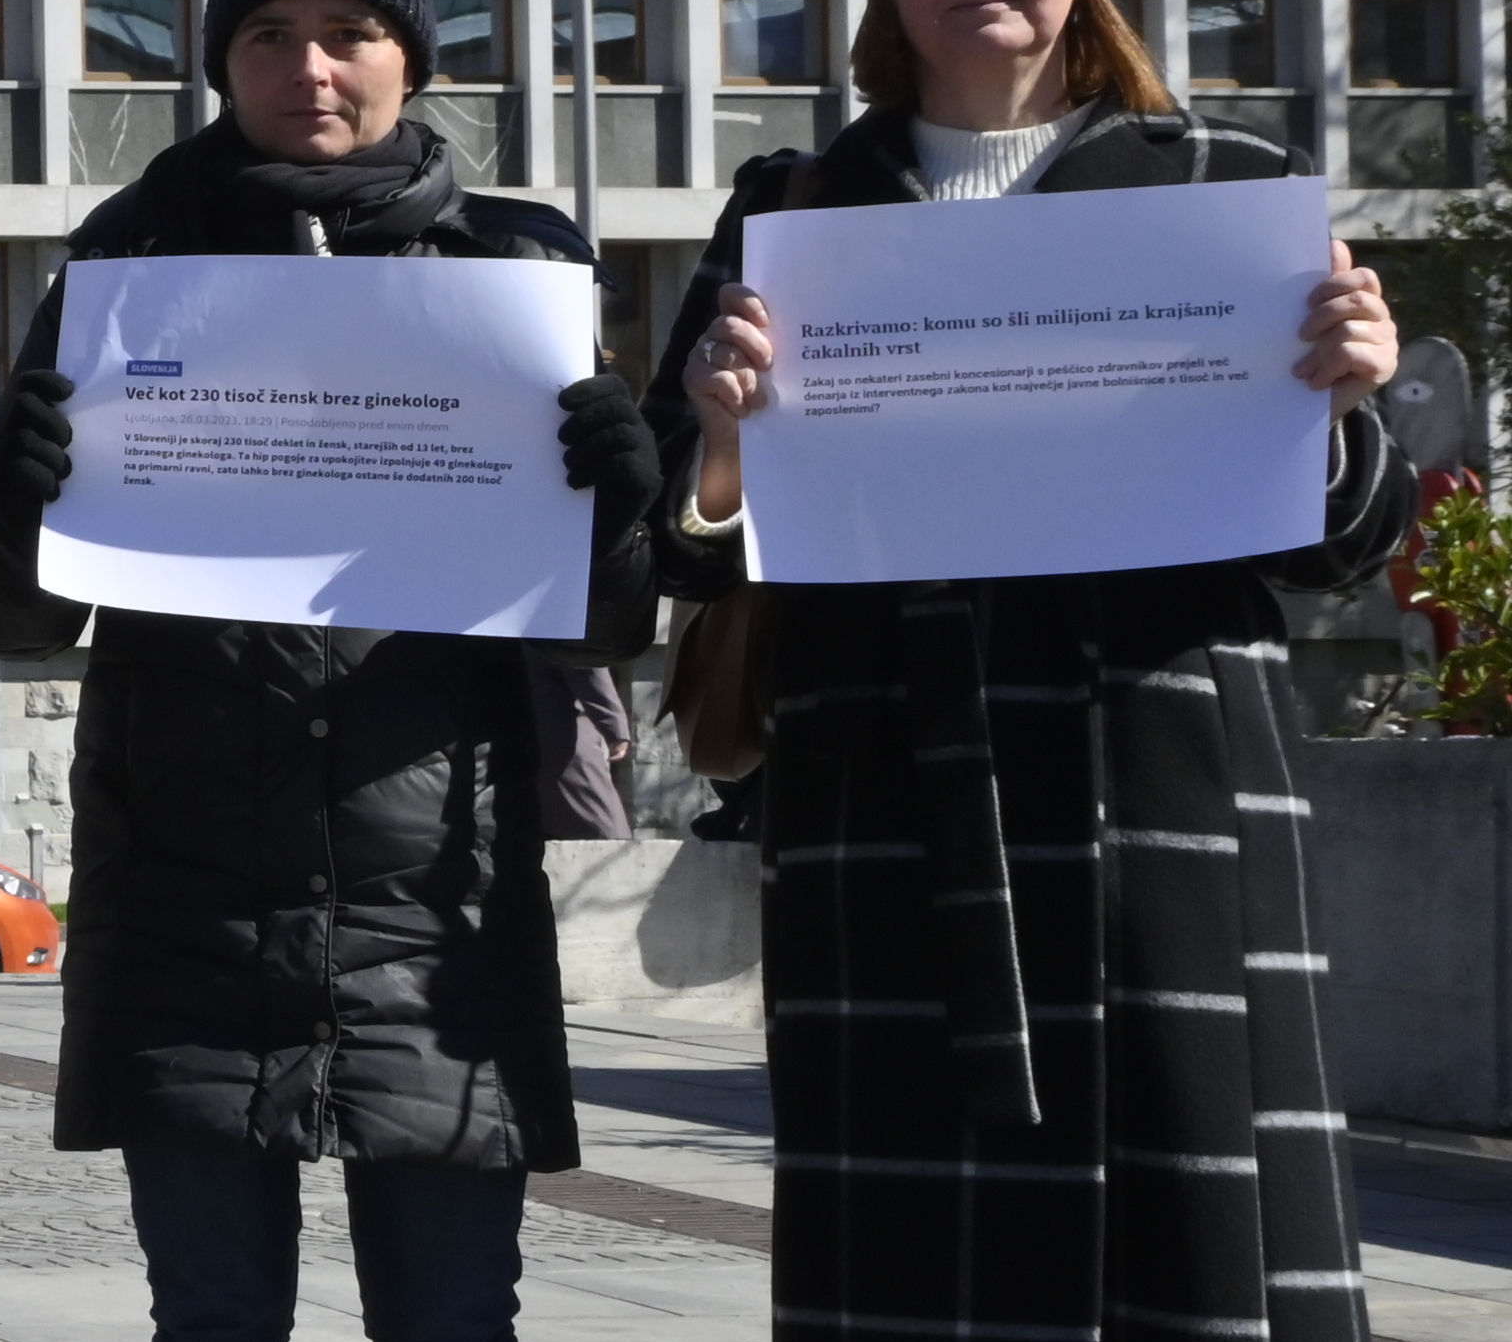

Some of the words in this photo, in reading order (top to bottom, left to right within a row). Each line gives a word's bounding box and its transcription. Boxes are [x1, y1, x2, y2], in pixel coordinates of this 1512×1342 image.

[801, 320, 918, 339] Razkrivamo:
[923, 316, 976, 332] komu
[981, 316, 1003, 328] so
[1007, 310, 1030, 327] šli
[1035, 306, 1112, 326] milijoni
[1117, 309, 1139, 321] za
[1144, 300, 1235, 321] krajšanje
[801, 341, 881, 360] čakalnih
[885, 341, 920, 356] vrst
[130, 363, 178, 374] SLOVENIJA
[803, 377, 835, 389] Zakaj
[837, 377, 852, 386] so
[854, 373, 903, 385] nekateri
[905, 370, 951, 383] zasebni
[953, 366, 1035, 380] koncesionarji
[1036, 367, 1044, 376] s
[1046, 364, 1095, 378] peščico
[1097, 361, 1164, 374] zdravnikov
[1166, 357, 1205, 372] prejeli
[1207, 357, 1230, 367] več
[125, 385, 155, 401] Več
[158, 386, 186, 402] kot
[189, 388, 220, 402] 230
[224, 388, 266, 404] tisoč
[269, 388, 318, 405] žensk
[323, 390, 361, 406] brez
[364, 391, 460, 413] ginekologa
[803, 391, 848, 402] denarja
[849, 390, 860, 400] iz
[862, 387, 944, 399] interventnega
[946, 384, 990, 395] zakona
[991, 382, 1012, 393] kot
[1014, 379, 1065, 393] največje
[1066, 379, 1100, 392] javne
[1102, 376, 1166, 388] bolnišnice
[1168, 375, 1176, 384] s
[1178, 372, 1210, 384] tisoč
[1212, 371, 1225, 382] in
[1227, 370, 1249, 381] več
[124, 433, 132, 442] V
[133, 433, 177, 446] Sloveniji
[177, 434, 189, 446] je
[190, 435, 222, 448] skoraj
[223, 436, 243, 446] 230
[243, 437, 270, 447] tisoč
[270, 438, 304, 448] deklet
[305, 438, 316, 449] in
[353, 441, 399, 453] starejših
[399, 442, 414, 452] od
[416, 443, 429, 453] 13
[450, 444, 474, 454] brez
